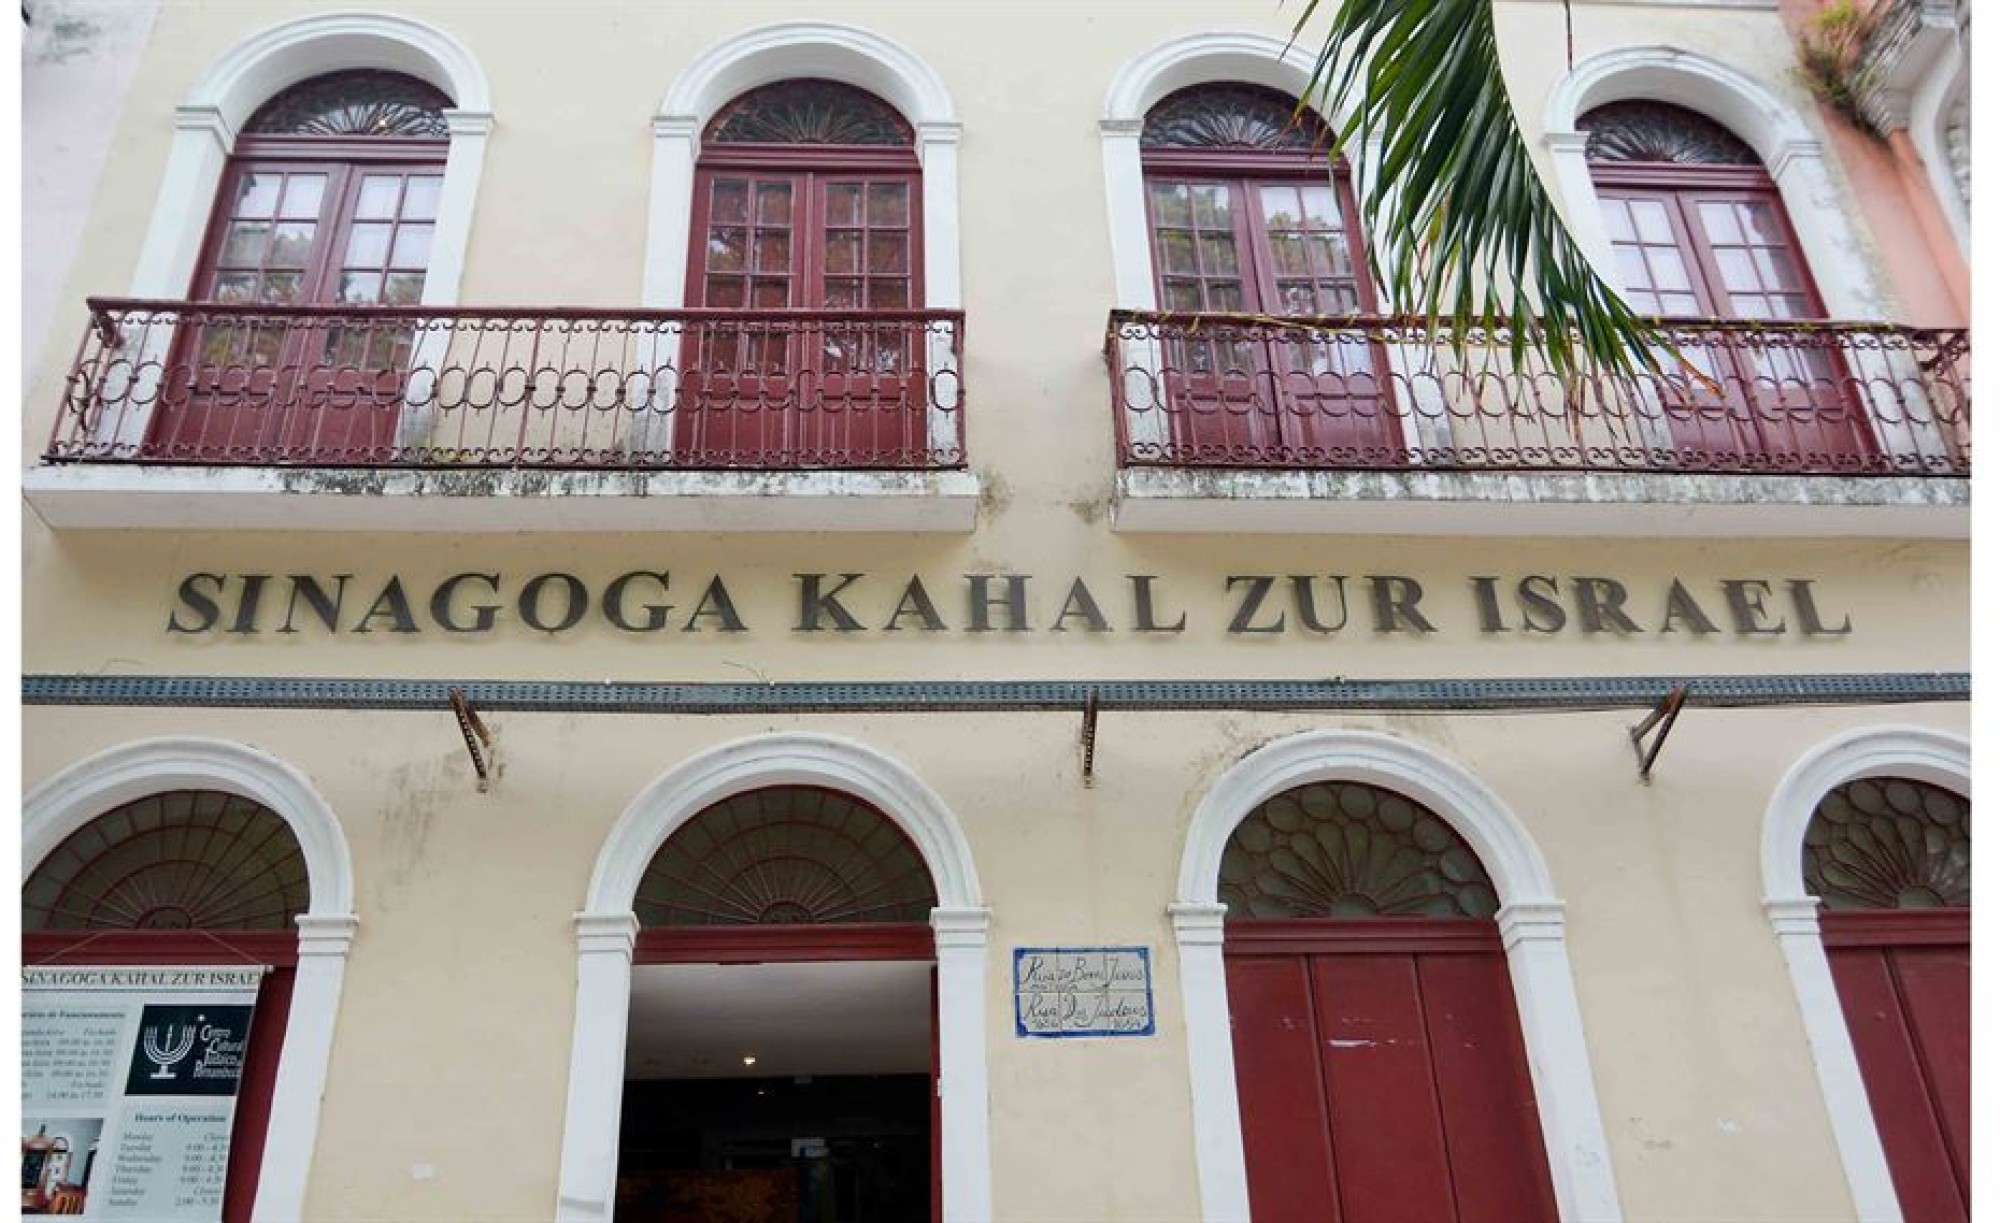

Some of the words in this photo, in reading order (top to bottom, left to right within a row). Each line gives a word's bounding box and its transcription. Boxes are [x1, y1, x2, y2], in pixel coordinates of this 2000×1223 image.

[167, 570, 748, 636] SINAGOGA
[791, 573, 1187, 633] KAHAL
[1226, 574, 1437, 634] ZUR
[1469, 574, 1853, 635] ISRAEL
[110, 971, 164, 986] KAHAL
[171, 971, 203, 986] ZUR
[1023, 956, 1055, 982] Rua
[135, 1112, 164, 1123] Hours
[165, 1112, 177, 1123] of
